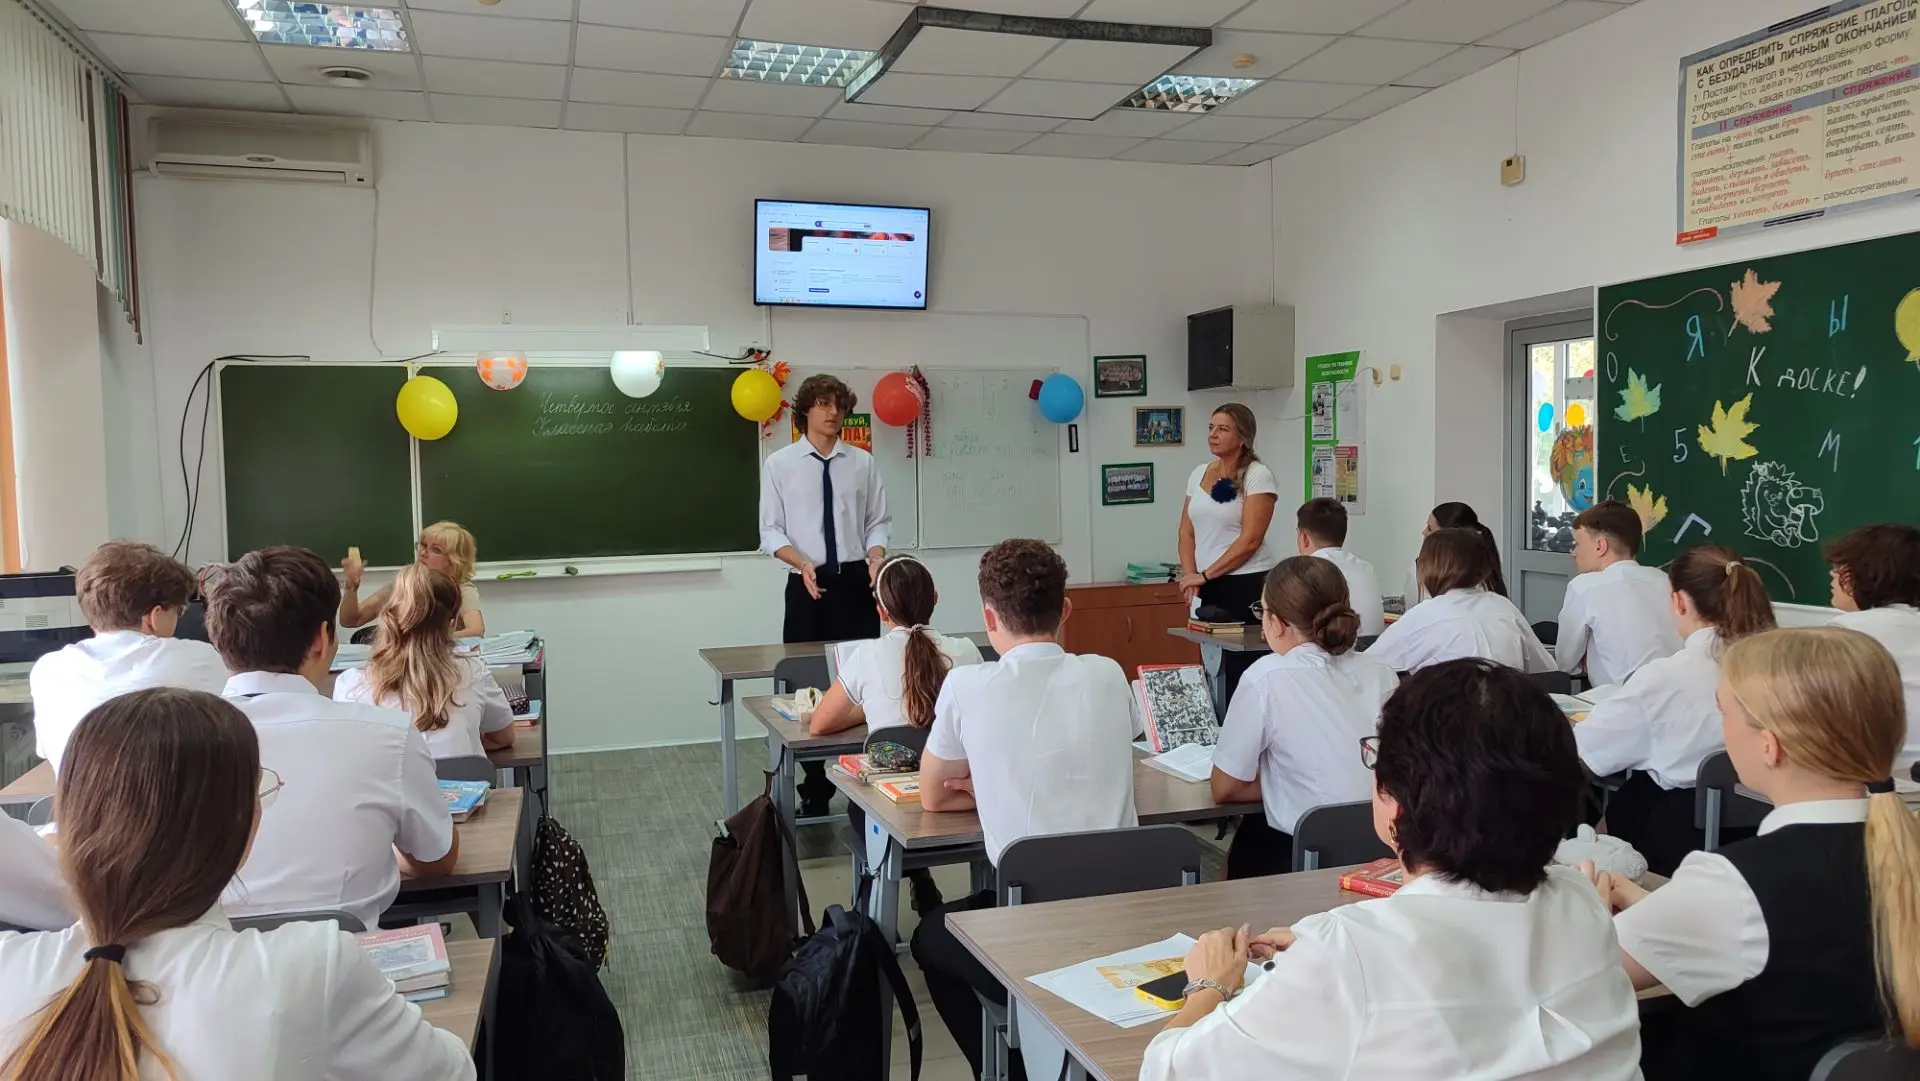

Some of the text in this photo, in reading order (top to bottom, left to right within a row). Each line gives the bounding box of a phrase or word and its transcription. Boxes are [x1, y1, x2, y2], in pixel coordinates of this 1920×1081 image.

[1696, 0, 1918, 78] КАК ОПРЕДЕЛИТЬ СПРЯЖЕНИЕ ГЛАГОЛА
[1697, 9, 1917, 89] С БЕЗУДАРНЫМ ЛИЧНЫМ ОКОНЧАНИЕМ
[1702, 101, 1756, 121] Определить,
[1758, 91, 1784, 105] какая
[1786, 80, 1824, 97] гласная
[1827, 70, 1853, 85] стоит
[1857, 60, 1888, 77] перед
[1703, 81, 1748, 100] Поставить
[1750, 70, 1777, 86] глагол
[1779, 69, 1785, 77] в
[1788, 41, 1872, 73] неопределённую
[1832, 68, 1913, 99] I спряжение
[1692, 96, 1728, 112] строит
[1719, 103, 1793, 132] II спряжение
[1826, 105, 1841, 115] Все
[1843, 92, 1885, 111] остальные
[1691, 139, 1720, 151] Глаголы
[1699, 214, 1730, 226] Глаголы
[1823, 177, 1908, 202] разноспрягаемые
[1829, 295, 1849, 338] Ы
[1686, 315, 1705, 362] Я
[1746, 346, 1766, 387] К
[1673, 427, 1688, 463] 5
